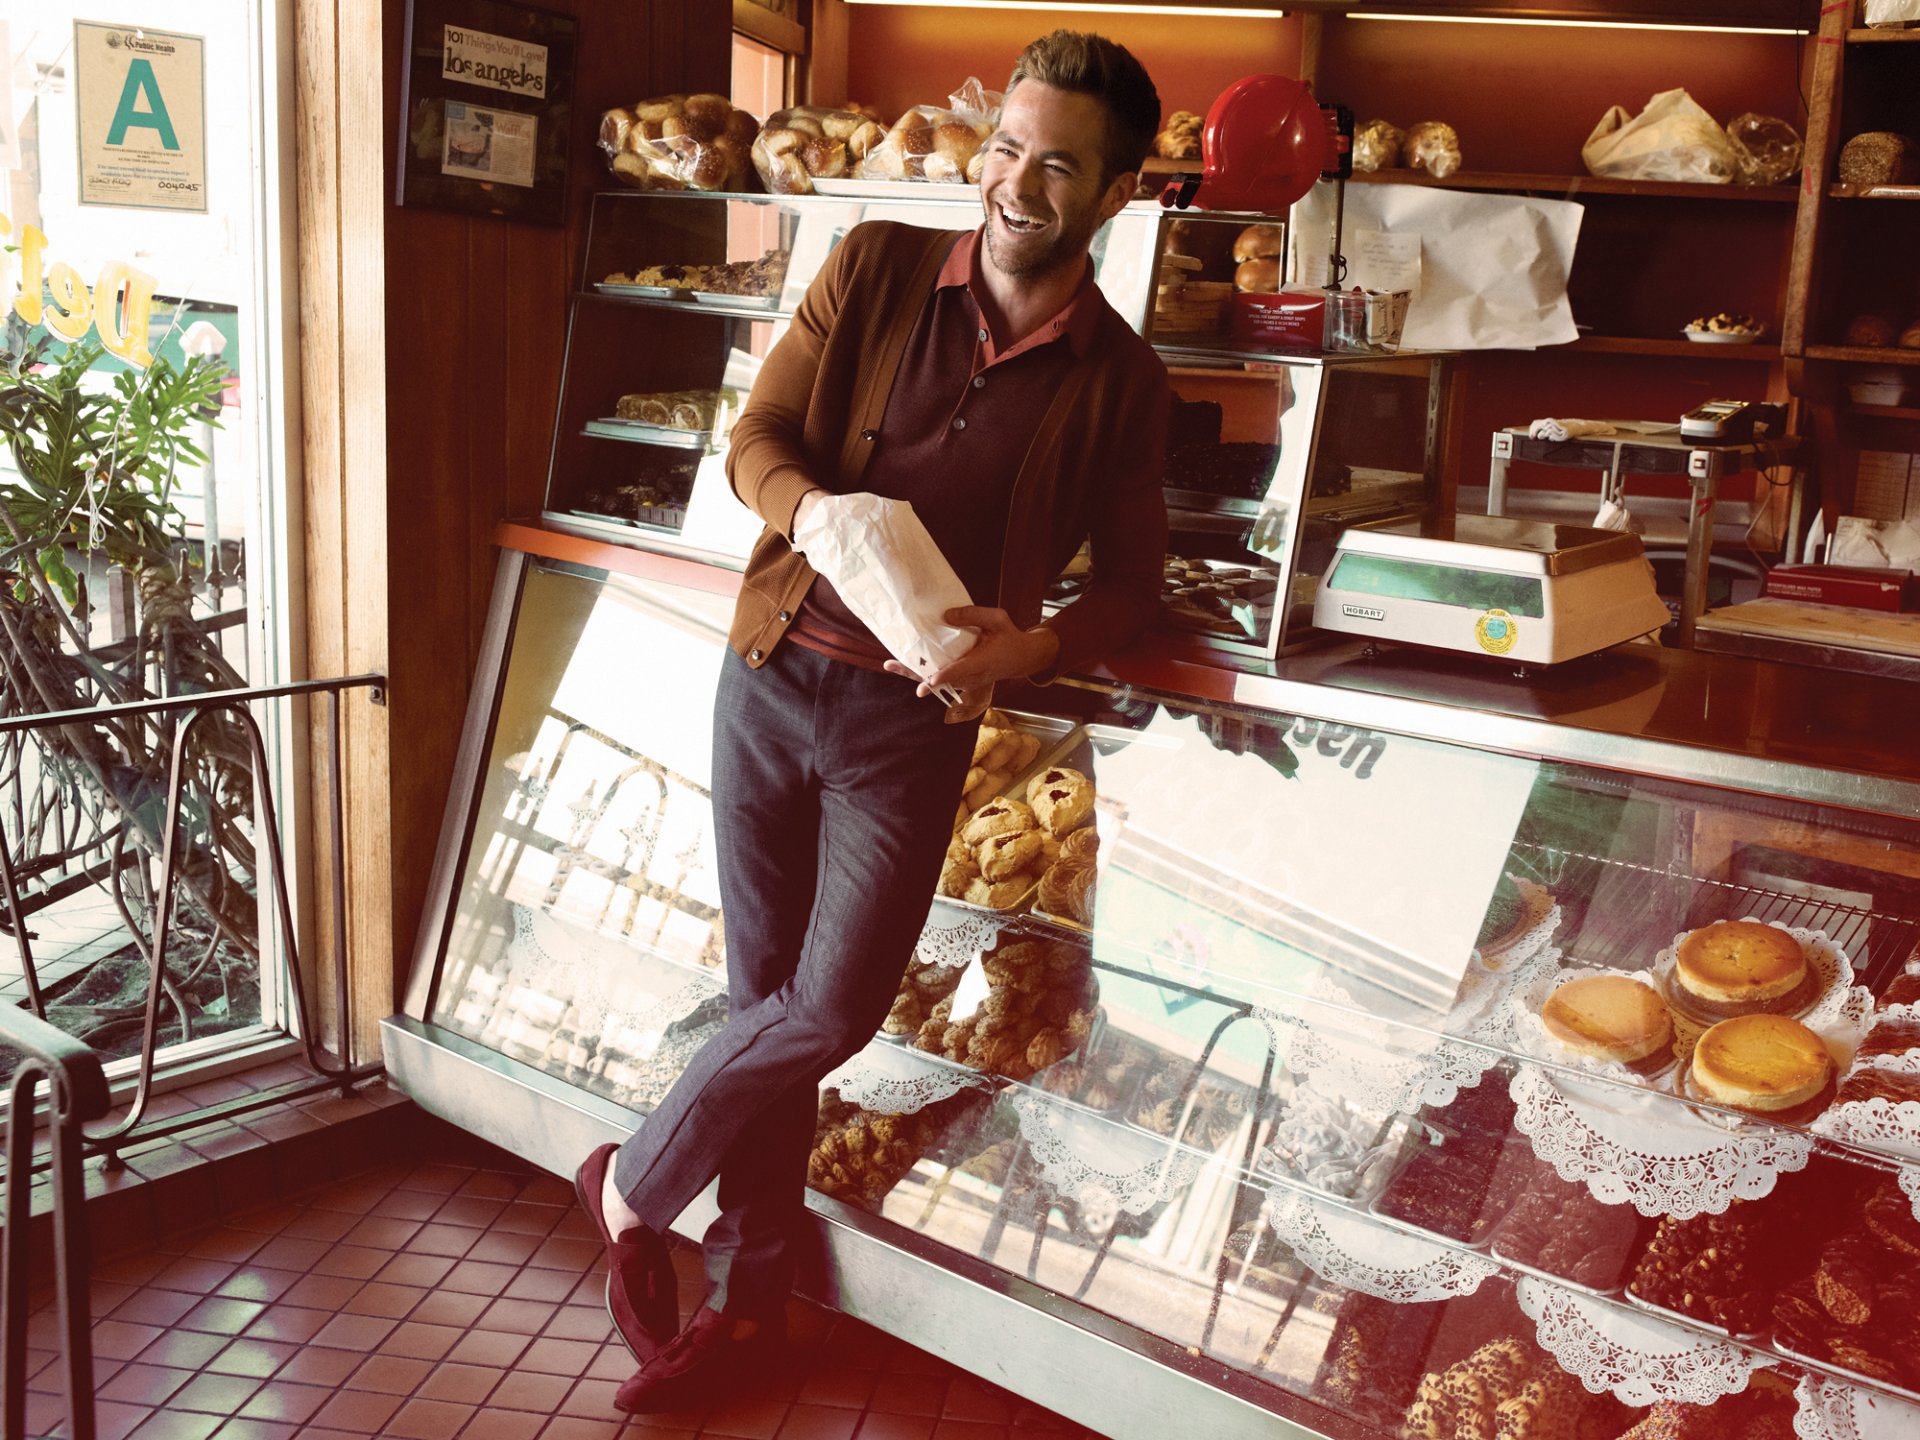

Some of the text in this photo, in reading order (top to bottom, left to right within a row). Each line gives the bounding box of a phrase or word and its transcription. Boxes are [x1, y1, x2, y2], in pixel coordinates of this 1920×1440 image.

[135, 41, 154, 51] Public
[155, 44, 176, 53] Health
[447, 29, 464, 44] 101
[464, 34, 496, 54] Things
[496, 40, 520, 57] You'll
[444, 47, 544, 90] los angeles
[106, 58, 181, 151] A
[1346, 606, 1382, 618] HOBART
